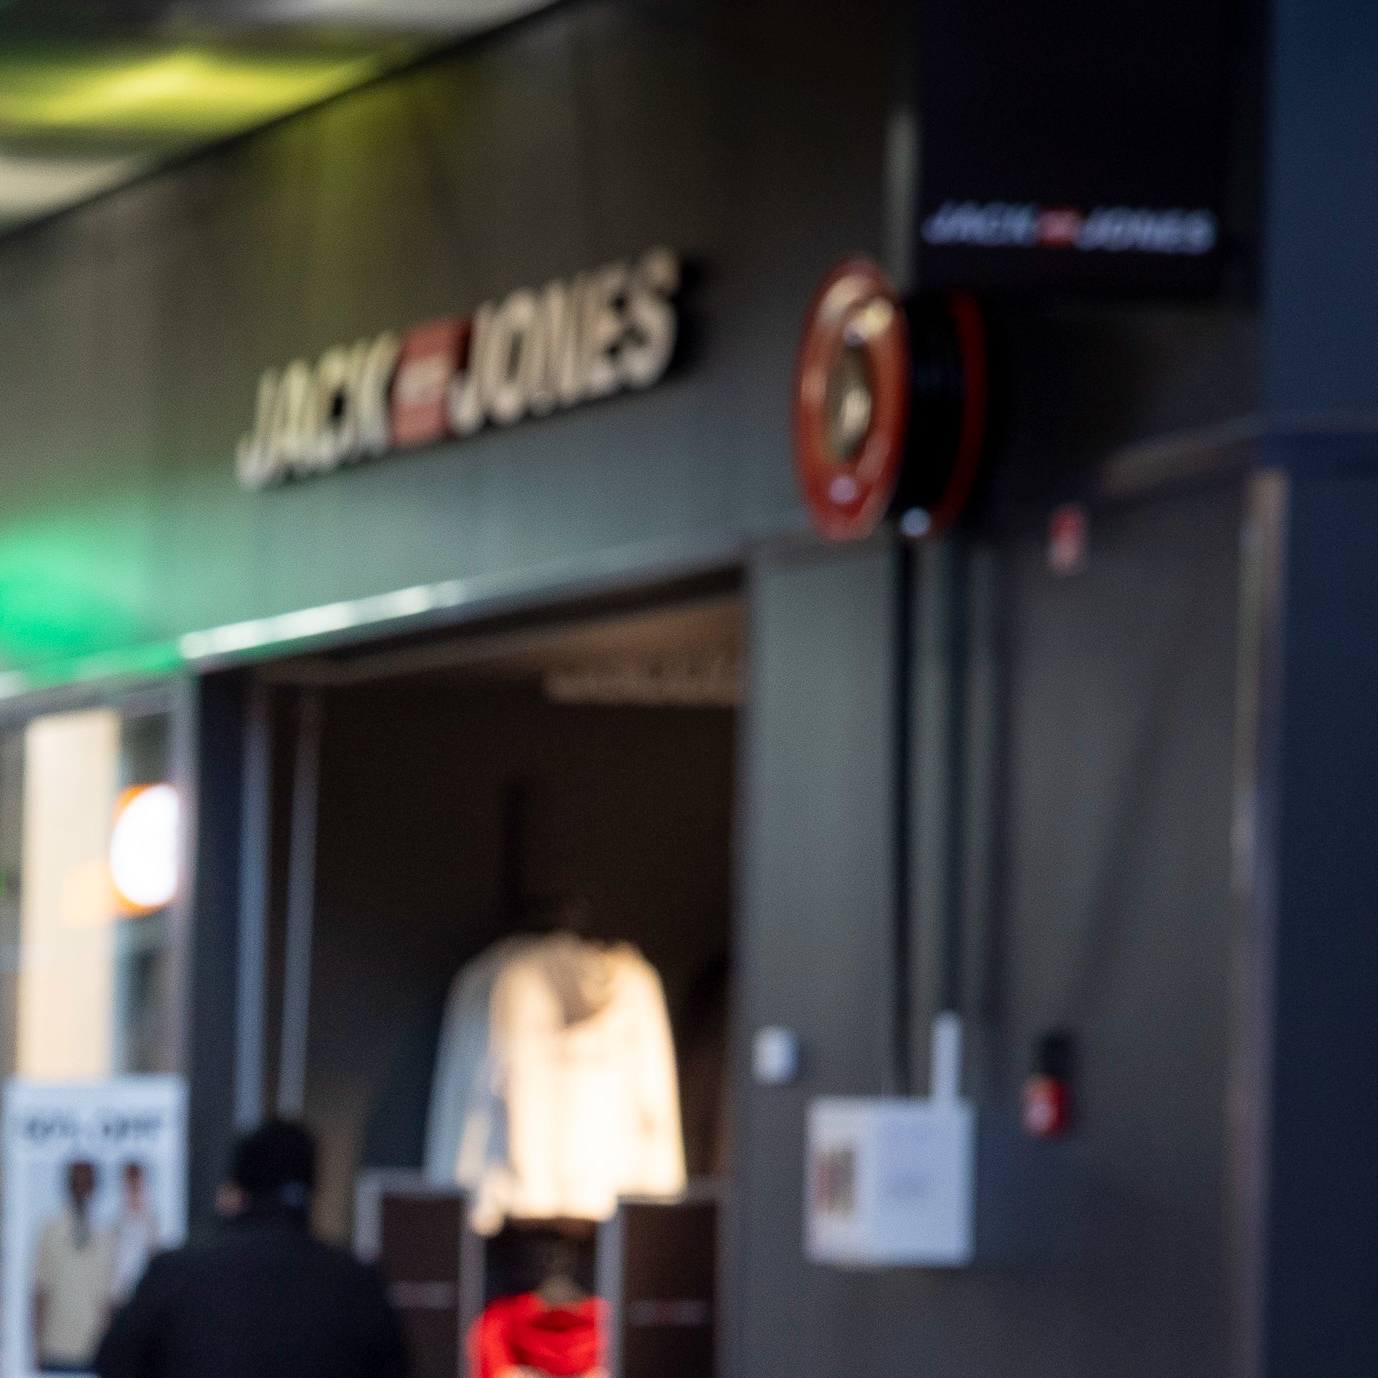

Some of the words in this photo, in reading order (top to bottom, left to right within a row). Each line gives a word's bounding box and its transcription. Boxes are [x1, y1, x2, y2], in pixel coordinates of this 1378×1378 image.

[921, 201, 1037, 245] JACK
[1079, 206, 1218, 255] JONES
[237, 329, 401, 490] JACK
[451, 246, 680, 436] JONES
